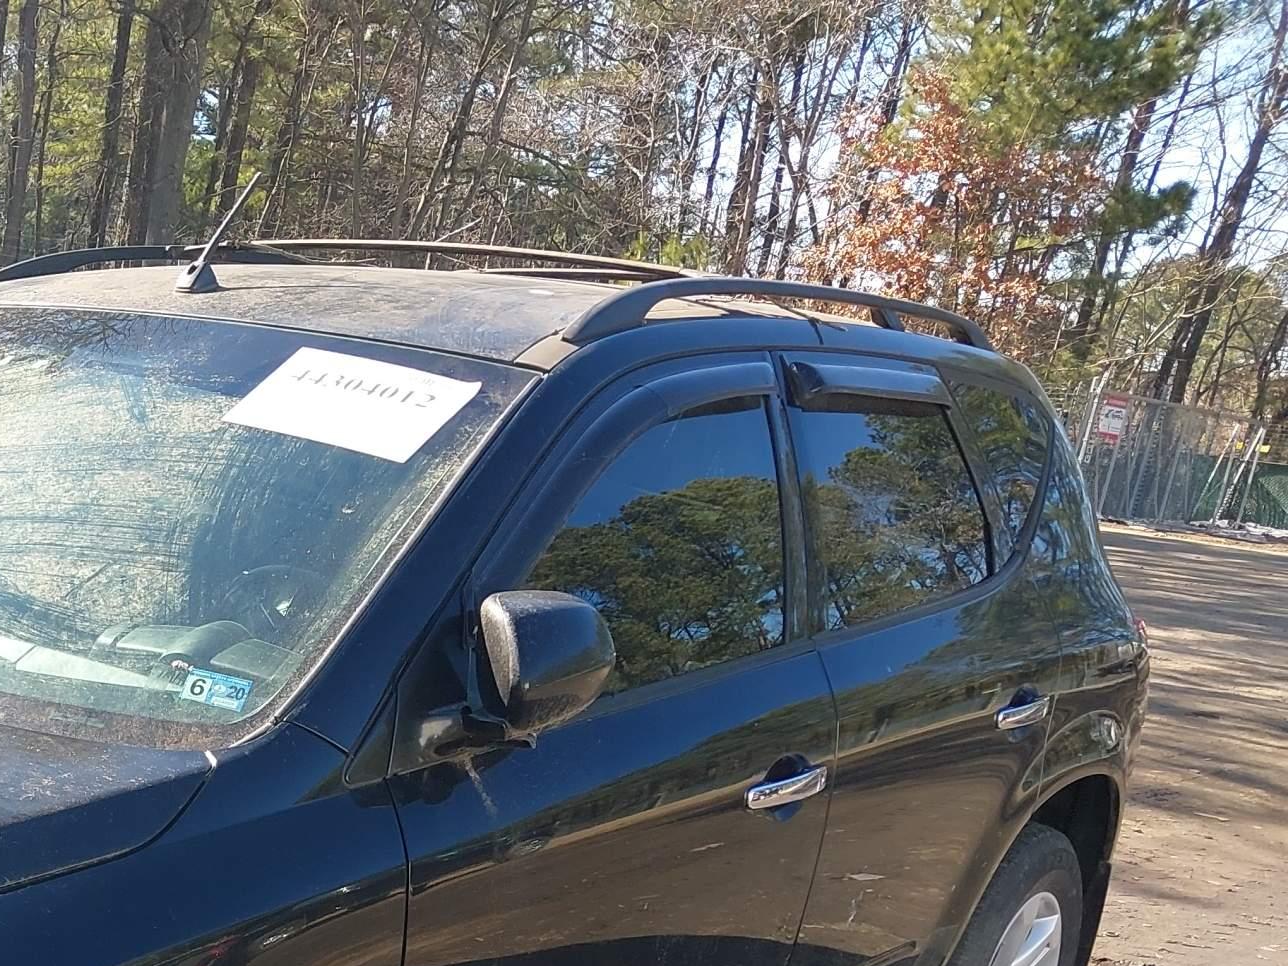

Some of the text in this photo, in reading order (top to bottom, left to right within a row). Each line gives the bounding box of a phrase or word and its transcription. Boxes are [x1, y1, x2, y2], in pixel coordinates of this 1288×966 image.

[292, 369, 437, 407] 44304012
[190, 678, 207, 696] 6
[226, 685, 246, 701] 20
